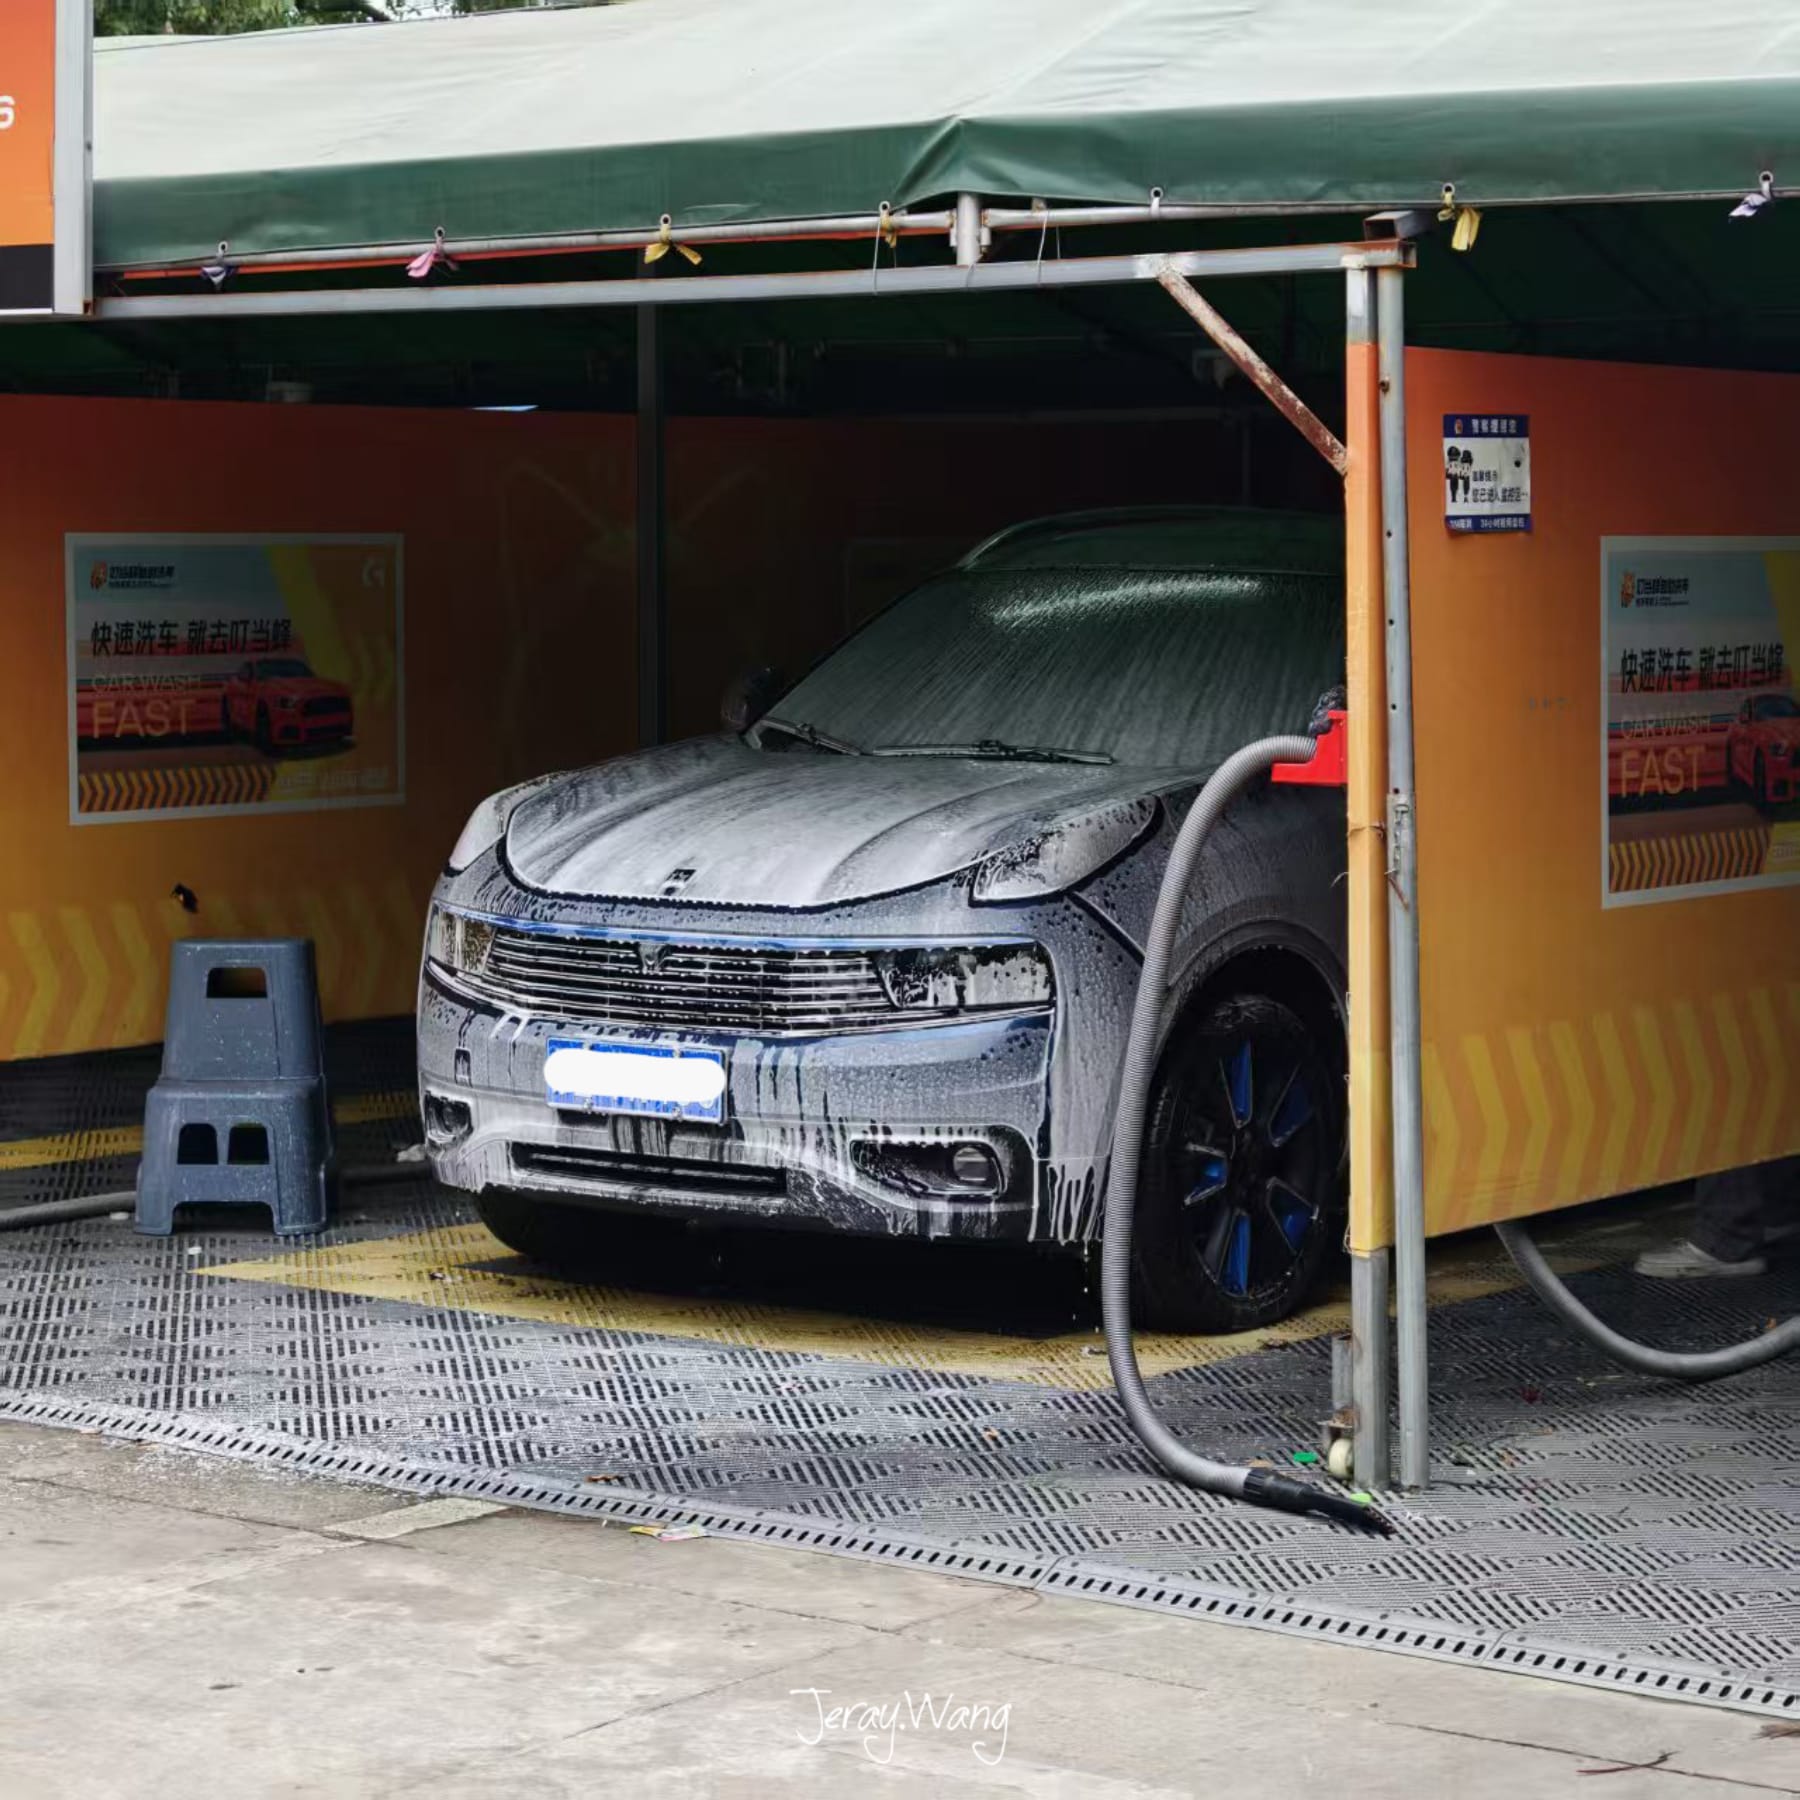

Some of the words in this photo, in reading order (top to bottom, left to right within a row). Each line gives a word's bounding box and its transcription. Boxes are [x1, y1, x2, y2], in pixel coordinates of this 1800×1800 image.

[91, 620, 178, 656] 快速洗车
[187, 618, 292, 654] 就去叮当蜂
[1621, 647, 1692, 693] 快速洗车
[1699, 643, 1785, 690] 就去叮当蜂
[92, 697, 197, 739] FAST
[1621, 714, 1656, 740] CAR
[1621, 747, 1706, 798] FAST
